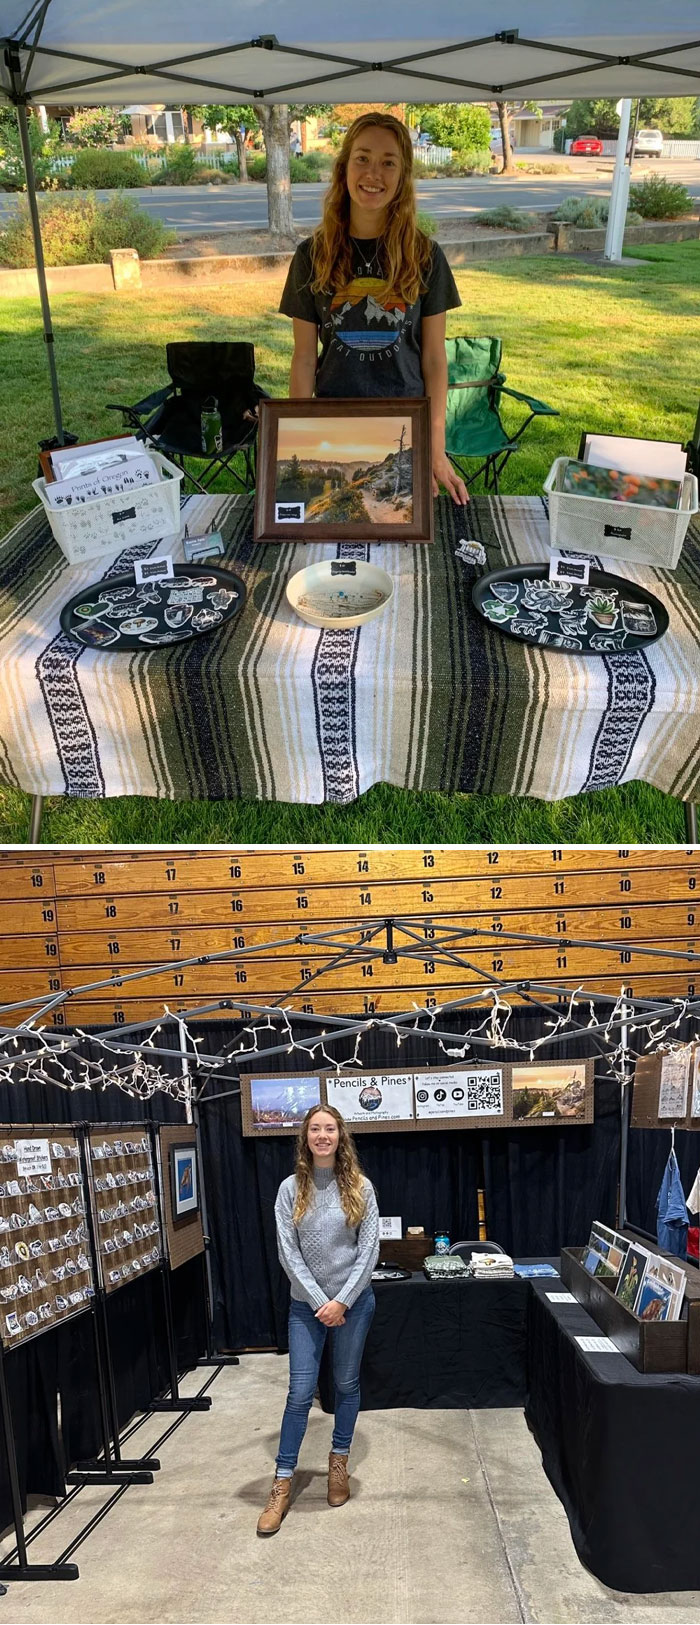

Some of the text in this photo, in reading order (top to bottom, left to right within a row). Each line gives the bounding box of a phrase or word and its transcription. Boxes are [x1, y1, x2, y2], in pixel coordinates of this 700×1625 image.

[93, 477, 100, 485] of
[102, 470, 128, 482] Oregon
[488, 852, 498, 864] 12
[552, 850, 561, 860] 11
[358, 861, 368, 872] 14
[424, 856, 434, 867] 13
[231, 866, 241, 878] 16
[294, 863, 304, 874] 15
[93, 872, 105, 884] 18
[166, 869, 175, 880] 17
[31, 875, 42, 887] 19
[620, 880, 631, 891] 10
[689, 878, 696, 889] 9
[491, 887, 501, 898] 12
[554, 882, 563, 893] 11
[297, 897, 308, 908] 15
[360, 893, 370, 905] 14
[169, 903, 178, 914] 17
[232, 900, 242, 911] 16
[42, 910, 53, 922] 19
[106, 906, 116, 917] 18
[620, 917, 631, 928] 10
[688, 914, 694, 925] 9
[557, 921, 566, 932] 11
[424, 928, 435, 938] 13
[108, 942, 119, 954] 18
[171, 939, 180, 950] 17
[234, 937, 244, 948] 16
[45, 944, 56, 956] 19
[558, 957, 566, 968] 11
[620, 952, 631, 963] 10
[362, 965, 372, 976] 14
[424, 962, 435, 973] 13
[492, 960, 503, 971] 12
[236, 971, 246, 982] 16
[300, 969, 311, 980] 15
[49, 979, 60, 990] 19
[173, 975, 183, 986] 17
[688, 985, 694, 996] 9
[302, 1005, 313, 1014] 15
[364, 1002, 375, 1013] 14
[52, 1014, 64, 1025] 19
[113, 1012, 124, 1023] 18
[334, 1076, 407, 1088] Pencils & Pines
